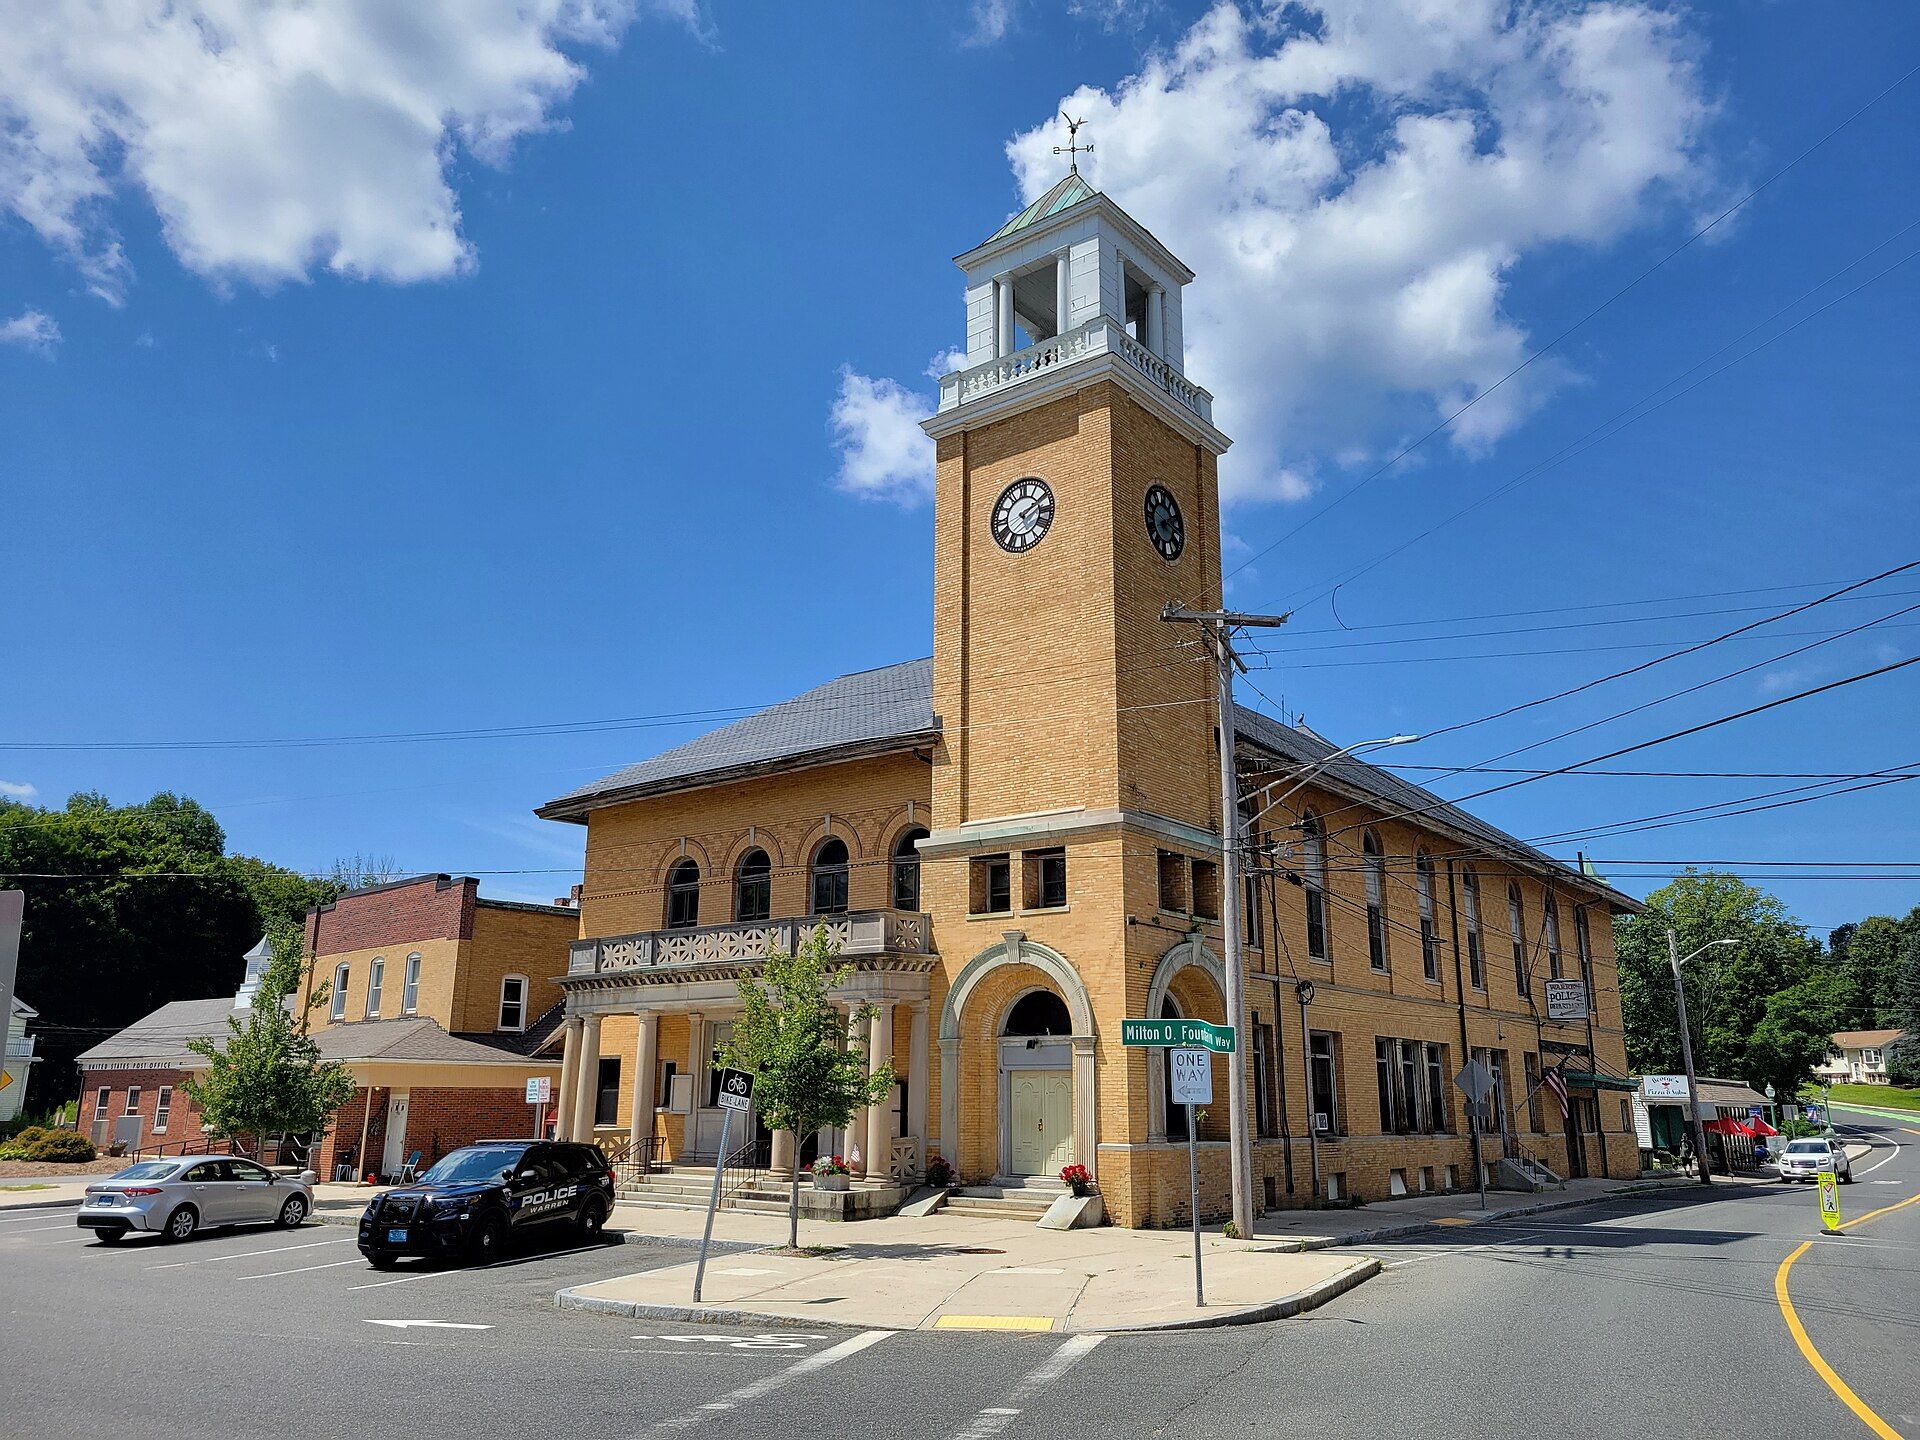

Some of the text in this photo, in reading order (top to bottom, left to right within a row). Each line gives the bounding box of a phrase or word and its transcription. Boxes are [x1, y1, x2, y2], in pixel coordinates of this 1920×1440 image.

[1126, 1025, 1160, 1041] Milton
[1164, 1025, 1177, 1041] O.
[1215, 1035, 1231, 1050] Way
[149, 1061, 172, 1069] OFFICE
[1176, 1054, 1205, 1067] ONE
[1176, 1068, 1206, 1082] WAY
[720, 1093, 748, 1109] BIKE LANE
[521, 1185, 577, 1208] POLICE
[530, 1199, 569, 1214] WARREN
